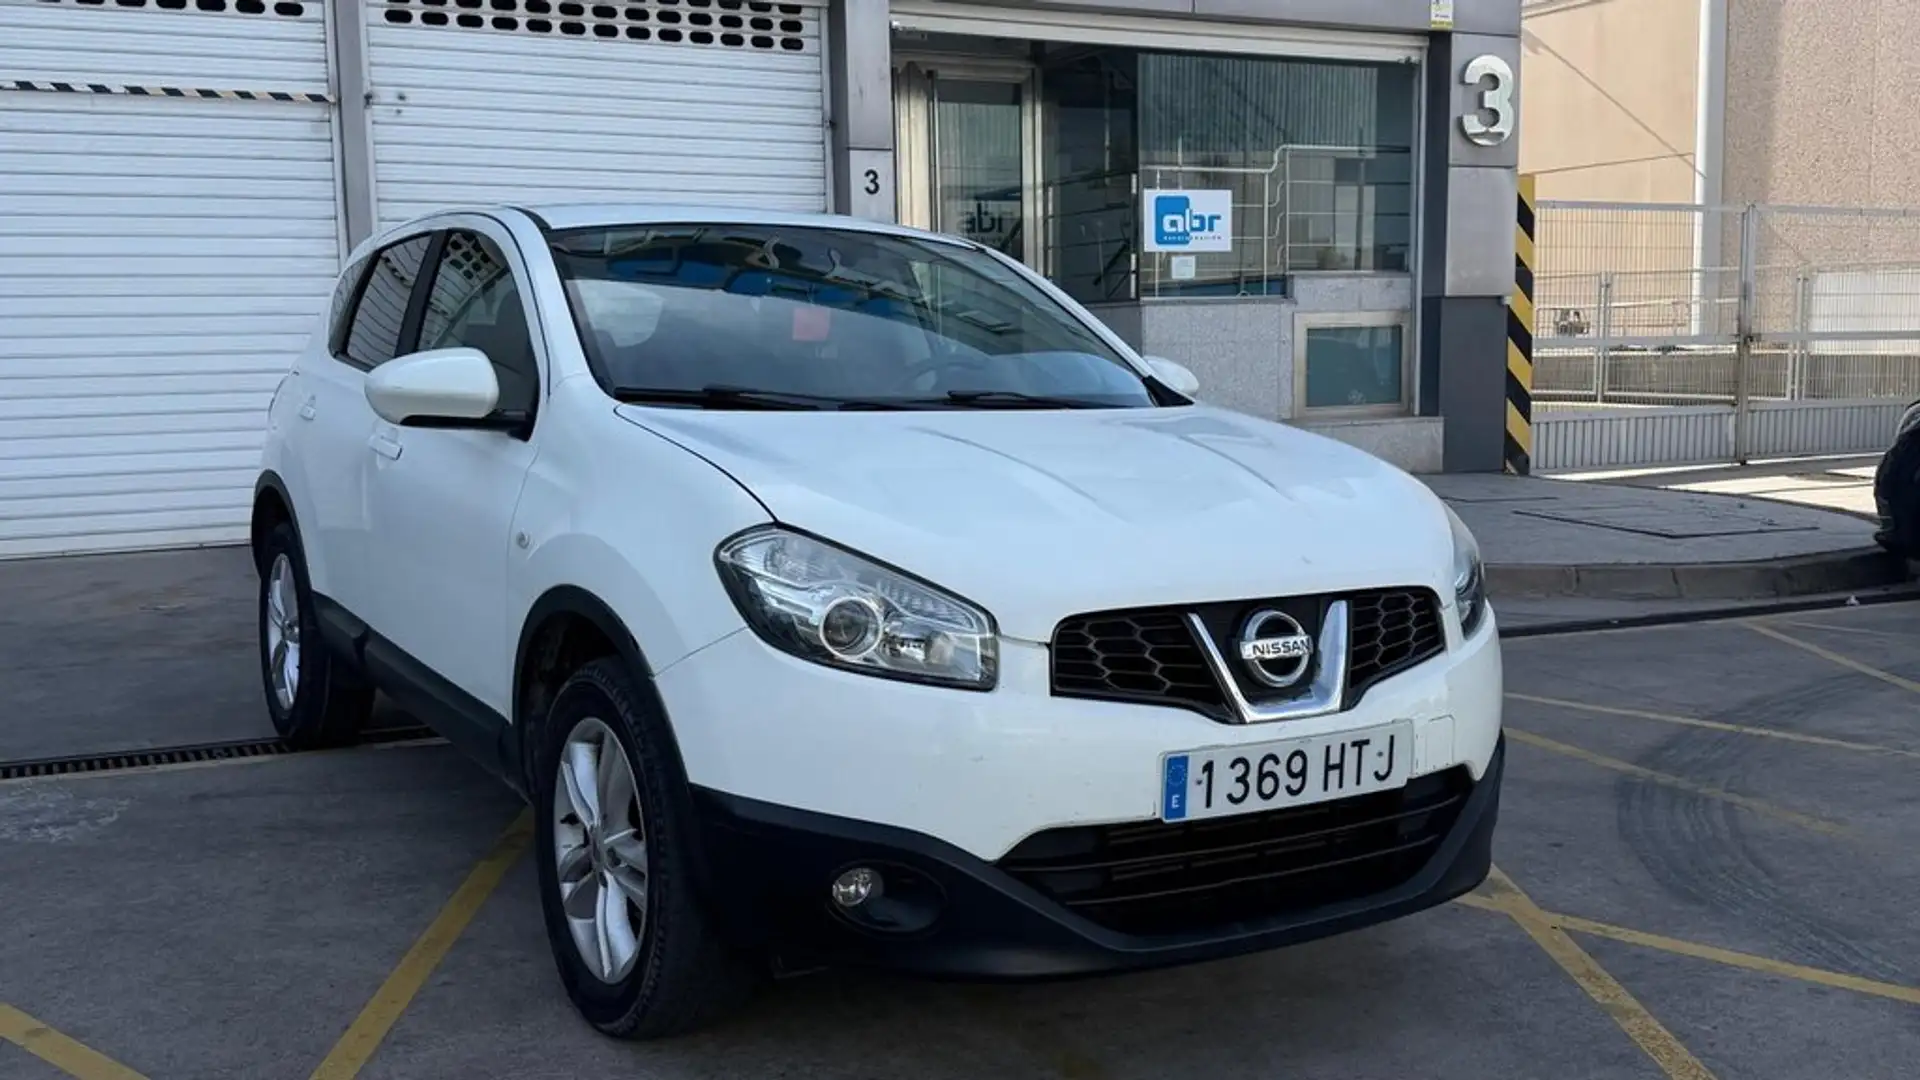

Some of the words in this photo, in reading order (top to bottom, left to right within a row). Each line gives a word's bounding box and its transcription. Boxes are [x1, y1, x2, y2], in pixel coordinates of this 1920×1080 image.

[1460, 54, 1515, 146] 3
[864, 168, 880, 195] 3
[1162, 207, 1222, 232] abr
[1252, 638, 1310, 656] NISSAN
[1171, 794, 1181, 809] E
[1201, 750, 1308, 809] 1369
[1323, 735, 1395, 792] HTJ
